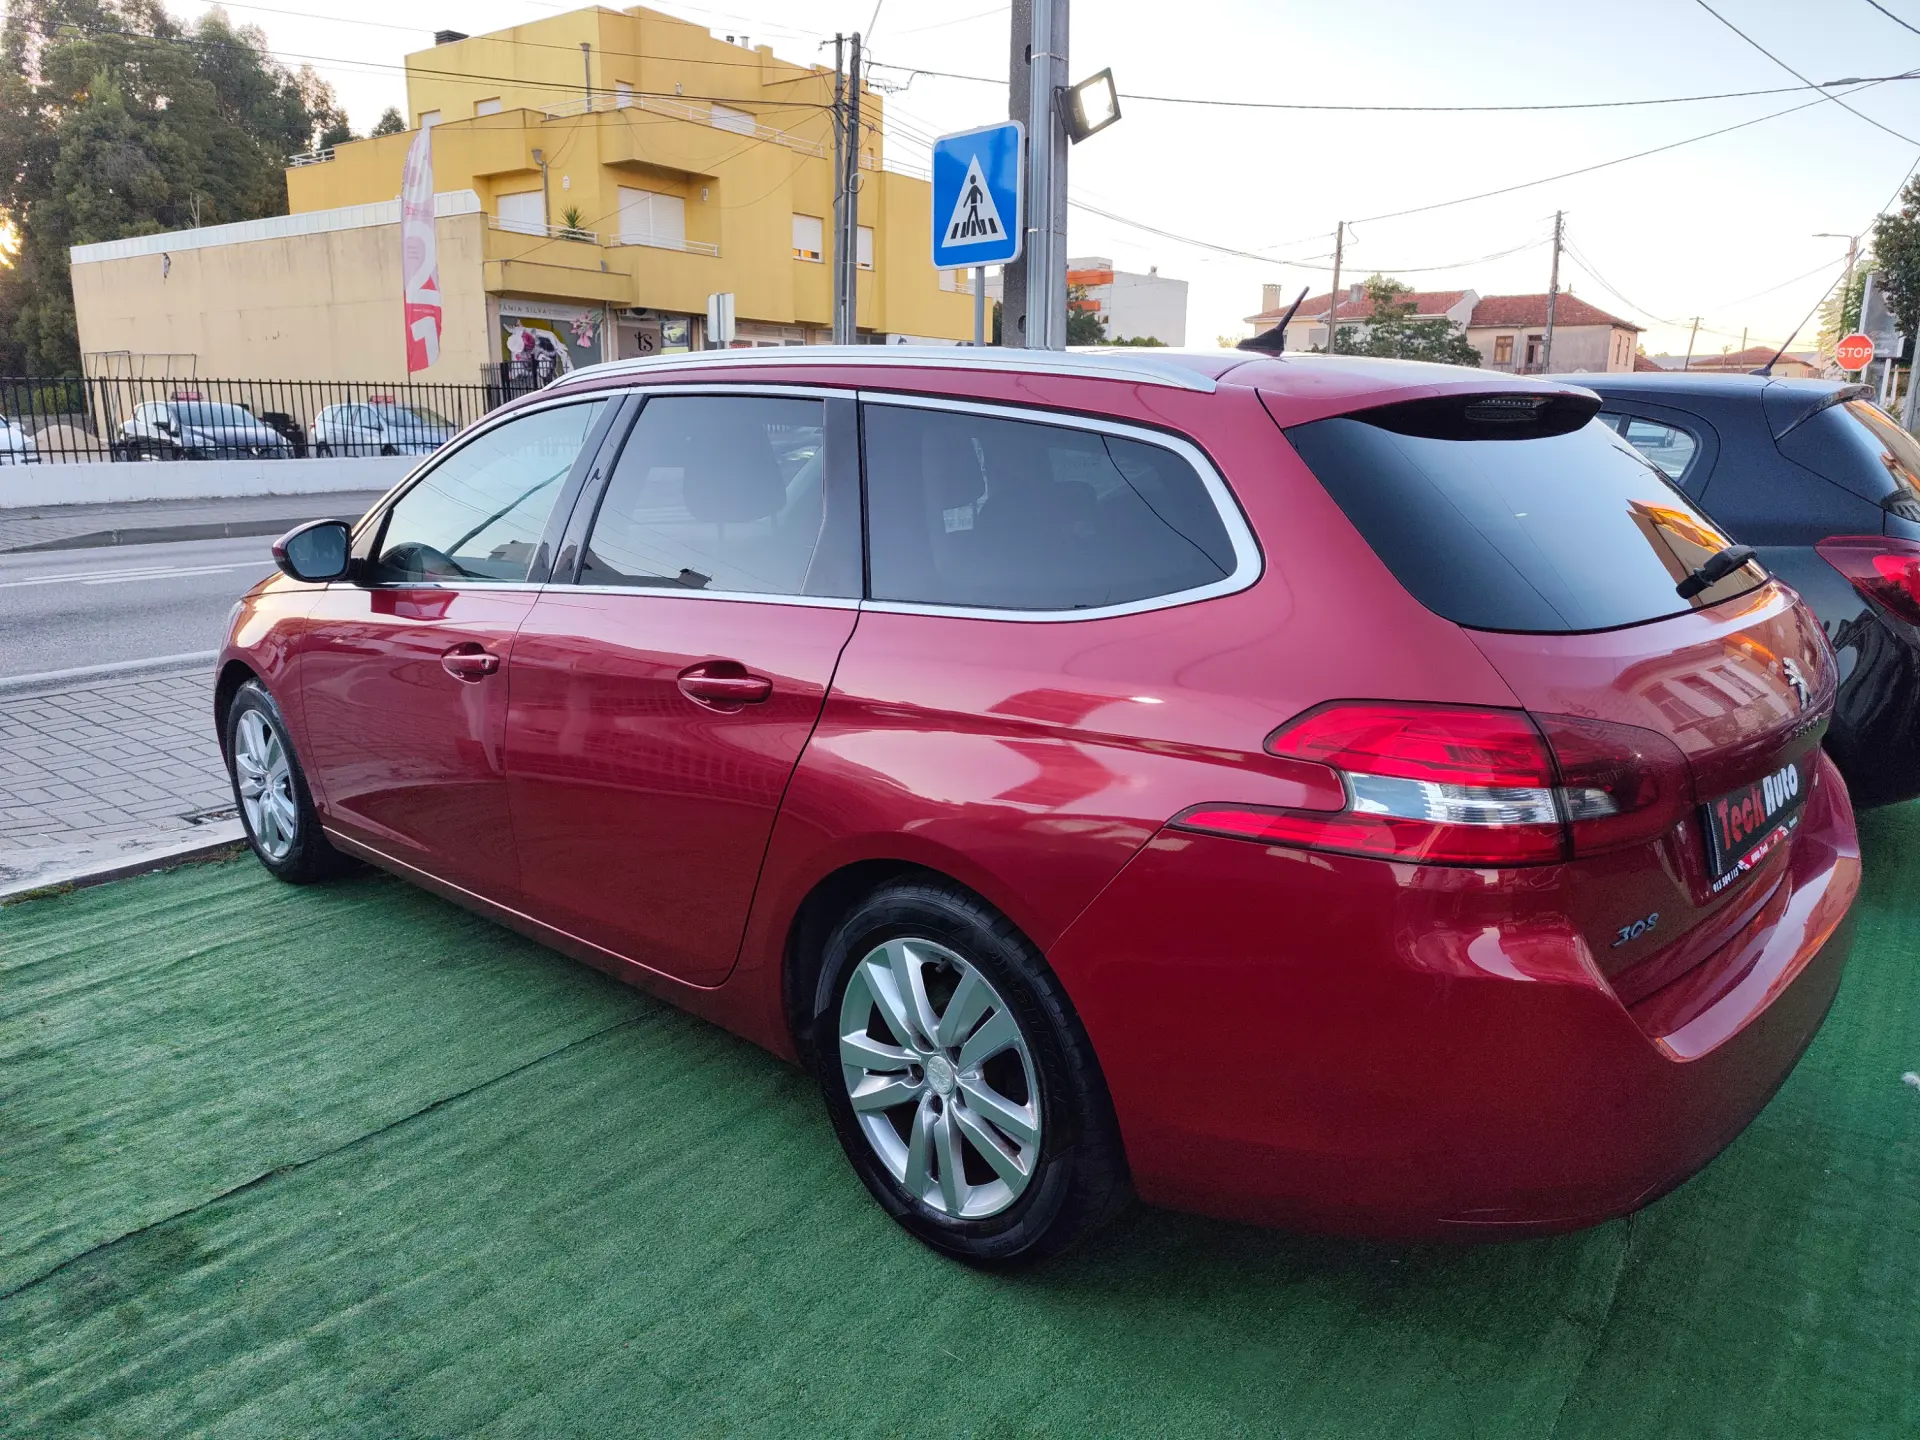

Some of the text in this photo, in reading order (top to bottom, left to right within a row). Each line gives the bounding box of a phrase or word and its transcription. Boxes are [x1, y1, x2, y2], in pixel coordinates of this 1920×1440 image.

[525, 306, 547, 314] SILVA
[1838, 347, 1872, 358] STOP
[1611, 912, 1659, 948] 308
